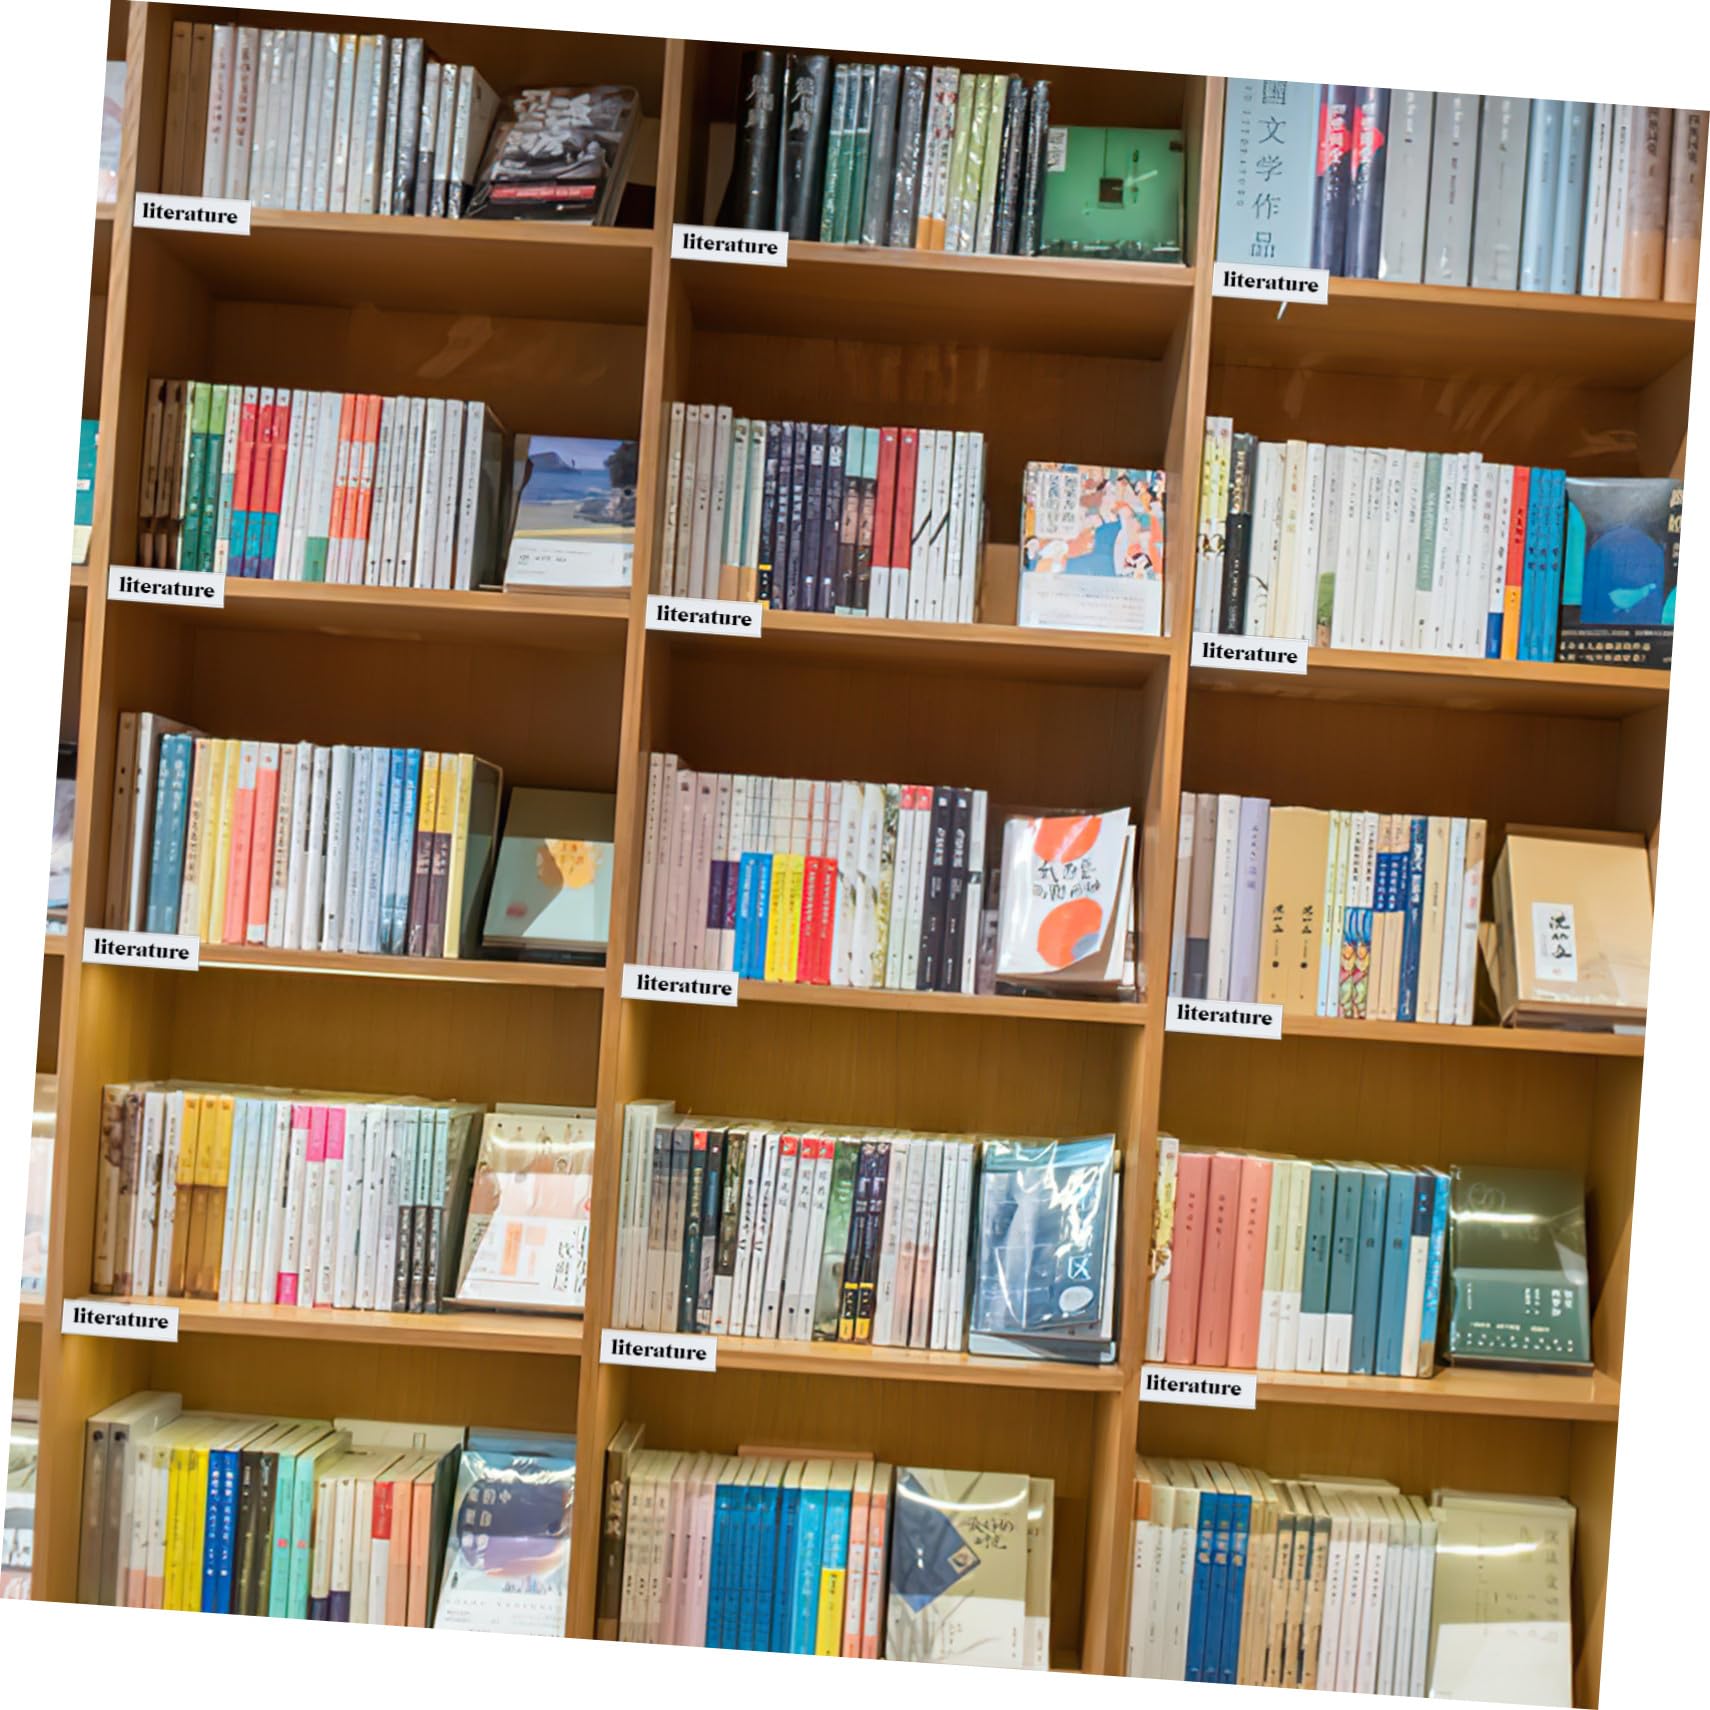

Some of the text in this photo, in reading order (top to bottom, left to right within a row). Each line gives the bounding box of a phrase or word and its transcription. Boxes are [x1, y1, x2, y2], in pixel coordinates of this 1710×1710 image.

[143, 202, 238, 224] literature
[683, 233, 778, 255] literature
[1223, 270, 1319, 293] literature
[119, 576, 215, 598] literature
[657, 604, 752, 627] literature
[1202, 642, 1298, 664] literature
[94, 938, 190, 960] literature
[637, 974, 732, 996] literature
[1177, 1003, 1273, 1026] literature
[73, 1307, 169, 1329] literature
[611, 1339, 707, 1361] literature
[1146, 1374, 1242, 1396] literature
